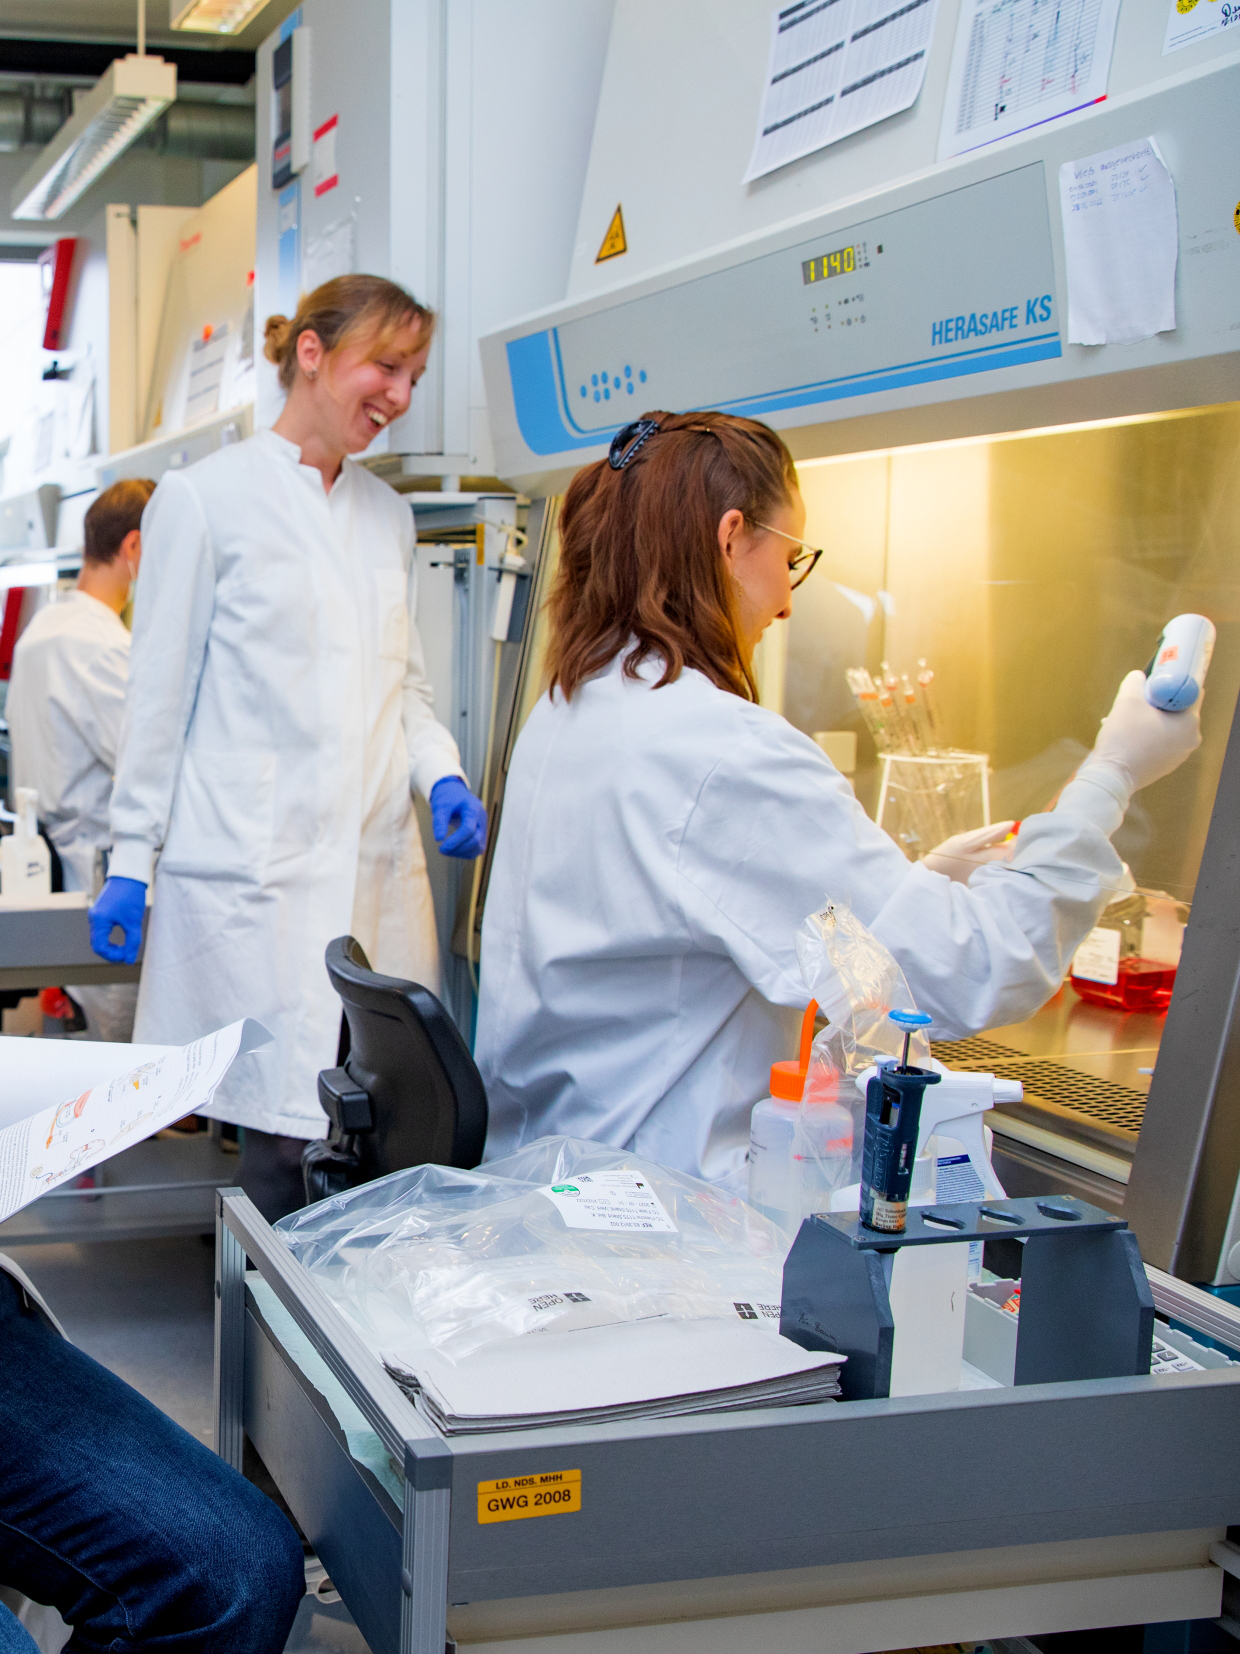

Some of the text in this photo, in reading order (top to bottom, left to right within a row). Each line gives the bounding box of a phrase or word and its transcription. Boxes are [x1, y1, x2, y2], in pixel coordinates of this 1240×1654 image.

[810, 247, 854, 281] 1140
[931, 295, 1053, 346] HERASAFE KS
[527, 1293, 558, 1304] HERE
[533, 1298, 563, 1312] OPEN
[760, 1310, 781, 1319] PEN
[496, 1474, 563, 1490] LD. NDS. MHH
[487, 1489, 571, 1512] GWG 2008
